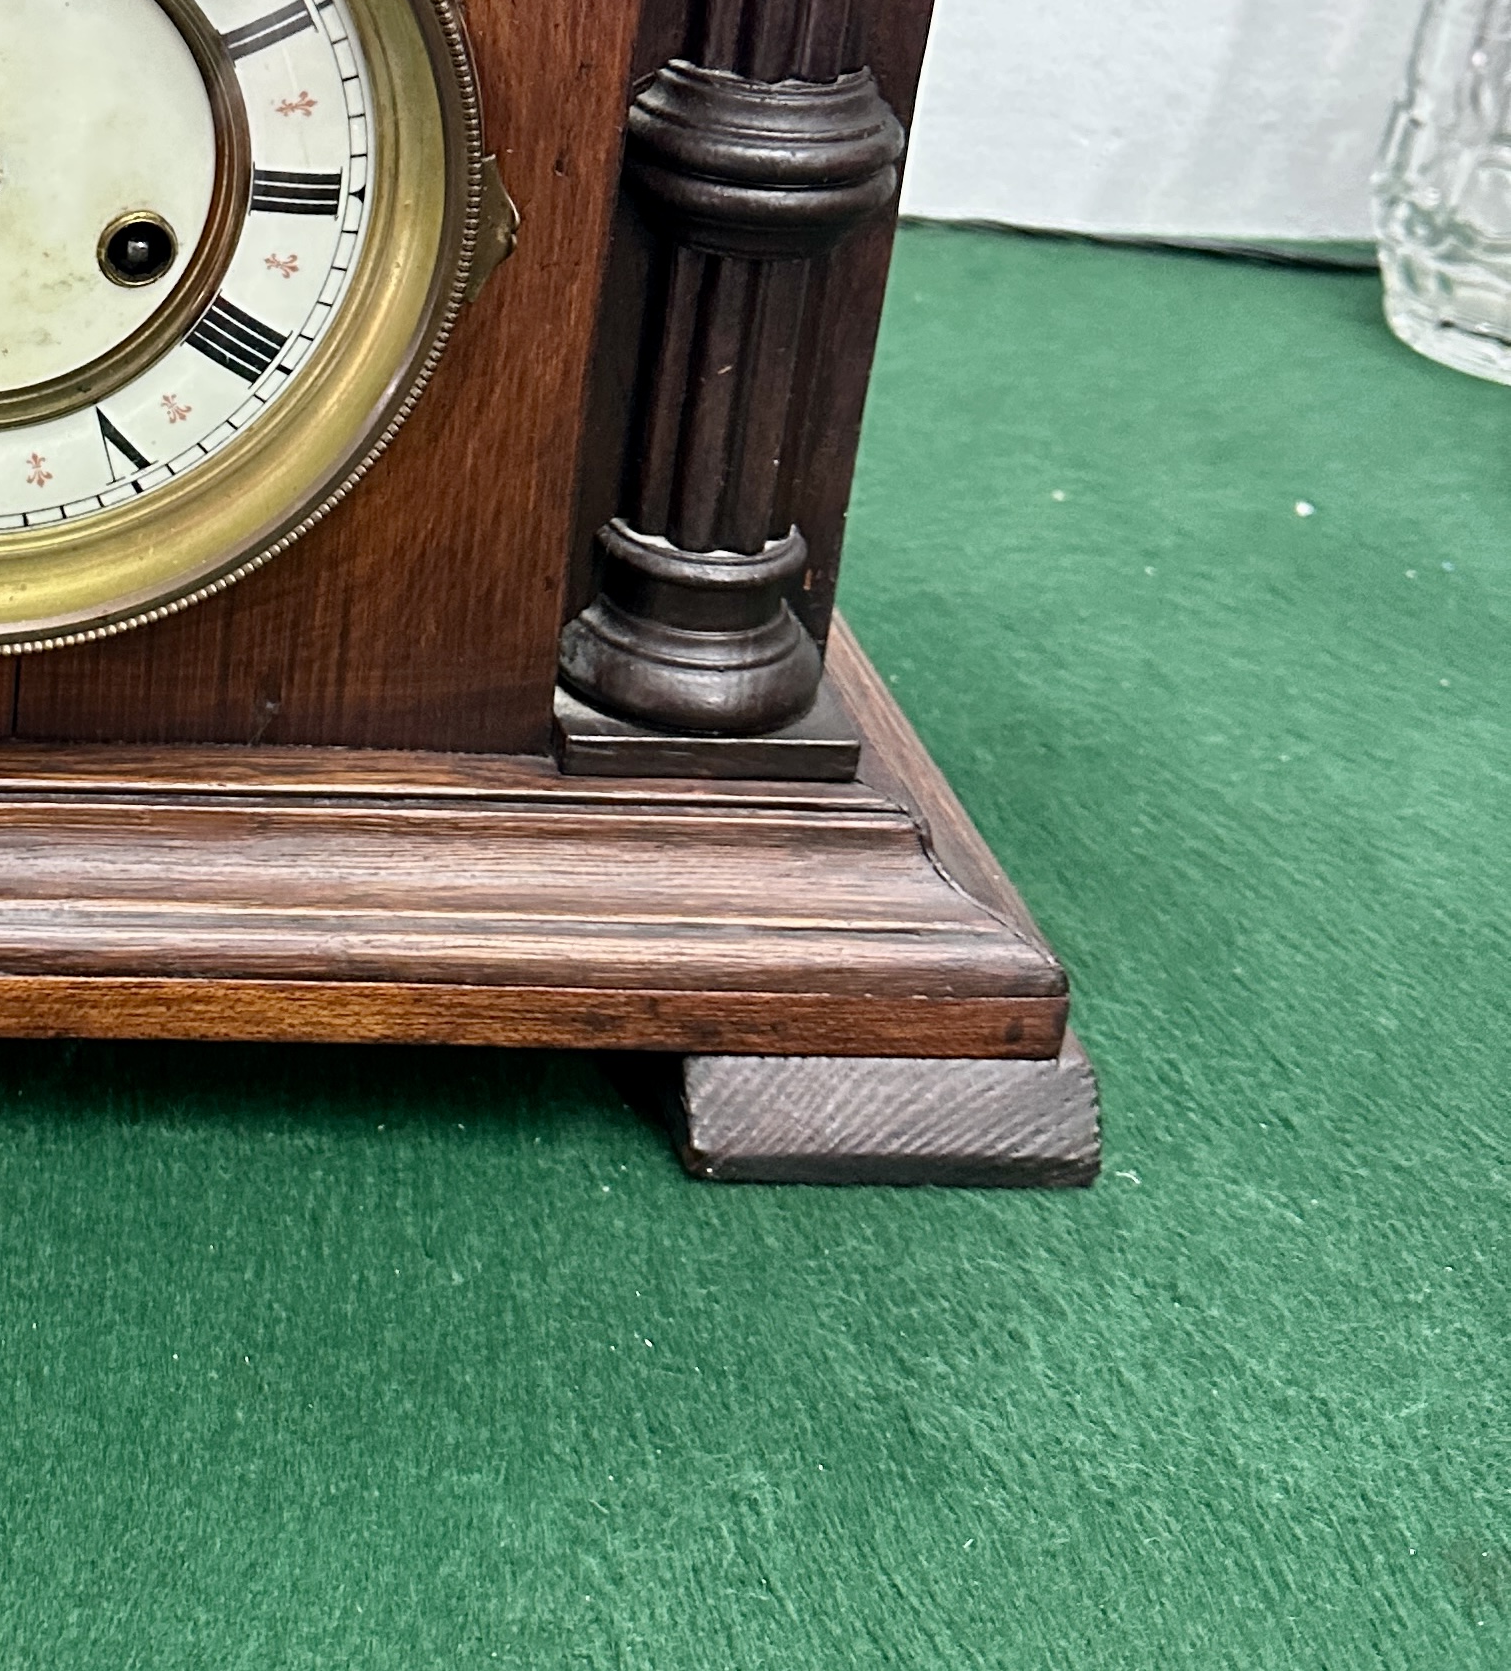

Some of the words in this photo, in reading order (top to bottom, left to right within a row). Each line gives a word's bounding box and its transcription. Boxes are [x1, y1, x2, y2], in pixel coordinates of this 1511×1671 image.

[248, 161, 344, 221] III
[180, 288, 294, 390] IIII
[95, 406, 159, 486] V
